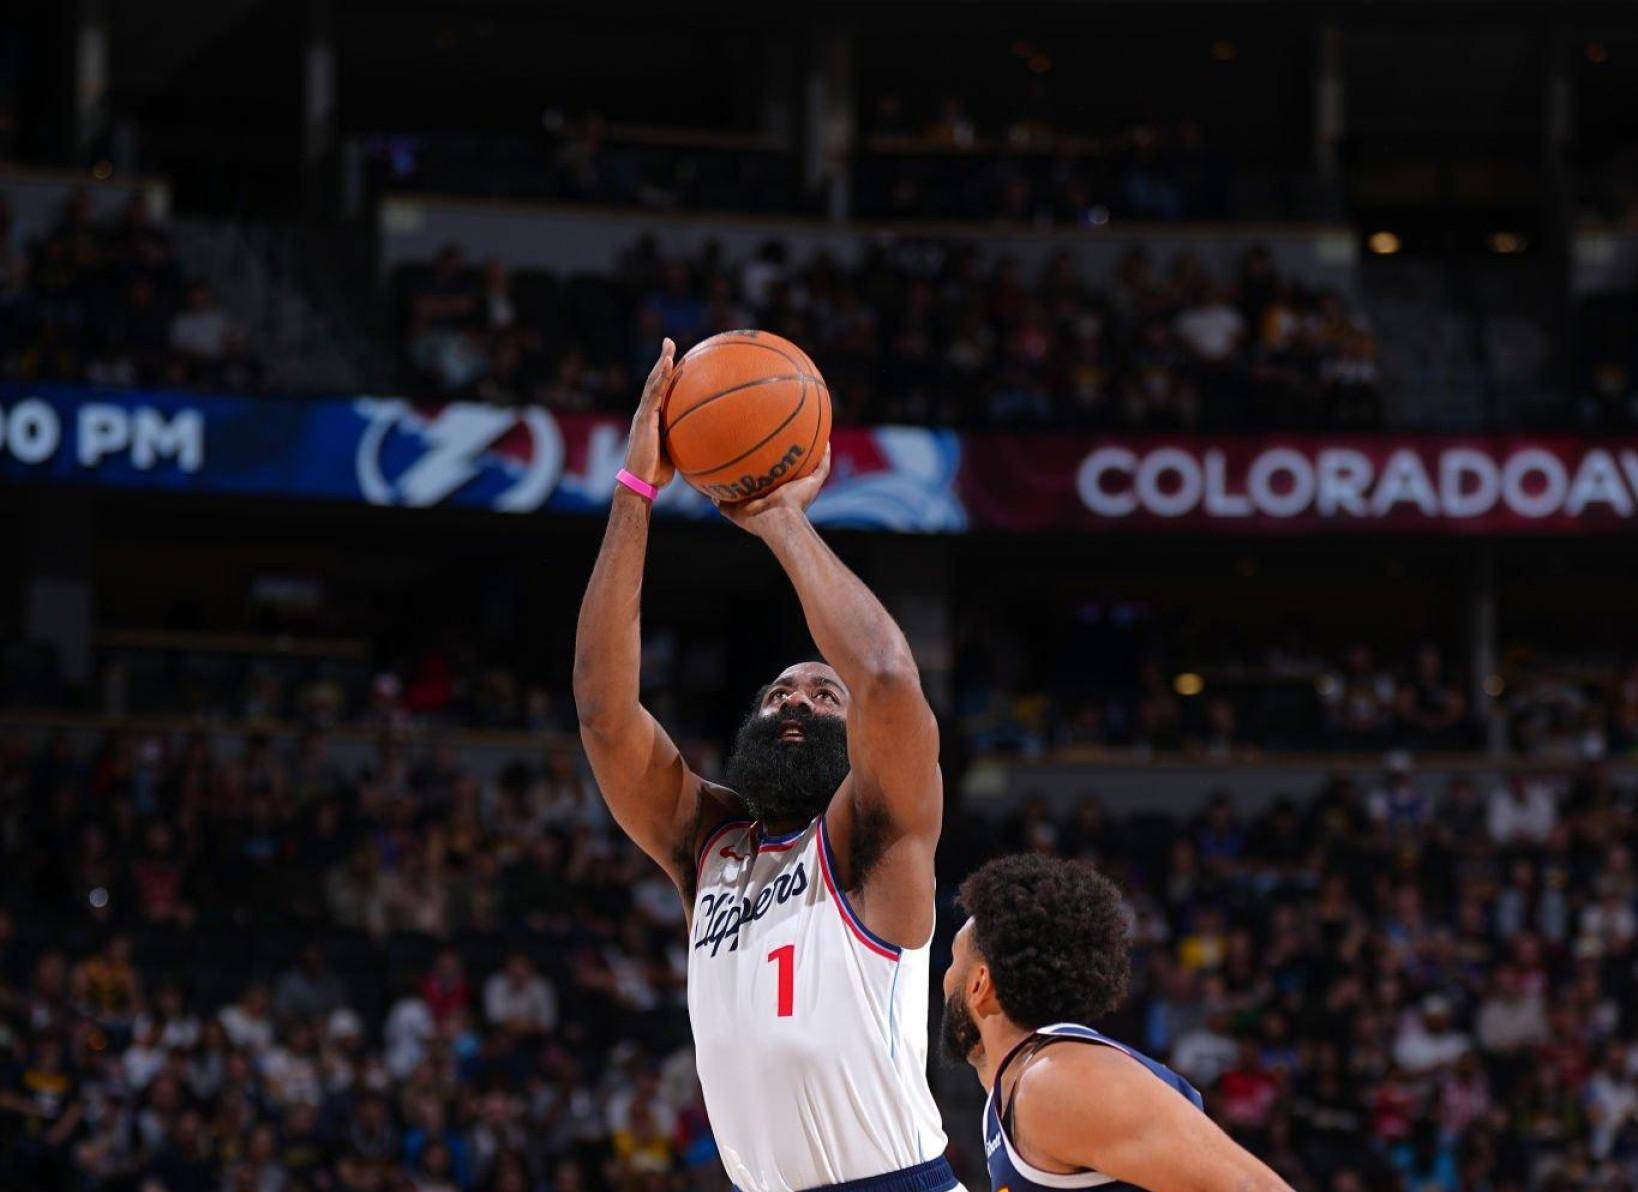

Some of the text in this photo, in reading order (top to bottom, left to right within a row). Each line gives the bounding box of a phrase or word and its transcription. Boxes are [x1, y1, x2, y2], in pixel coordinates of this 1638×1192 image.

[77, 404, 202, 472] PM
[1077, 446, 1638, 518] COLORADOA
[767, 944, 795, 1018] 1
